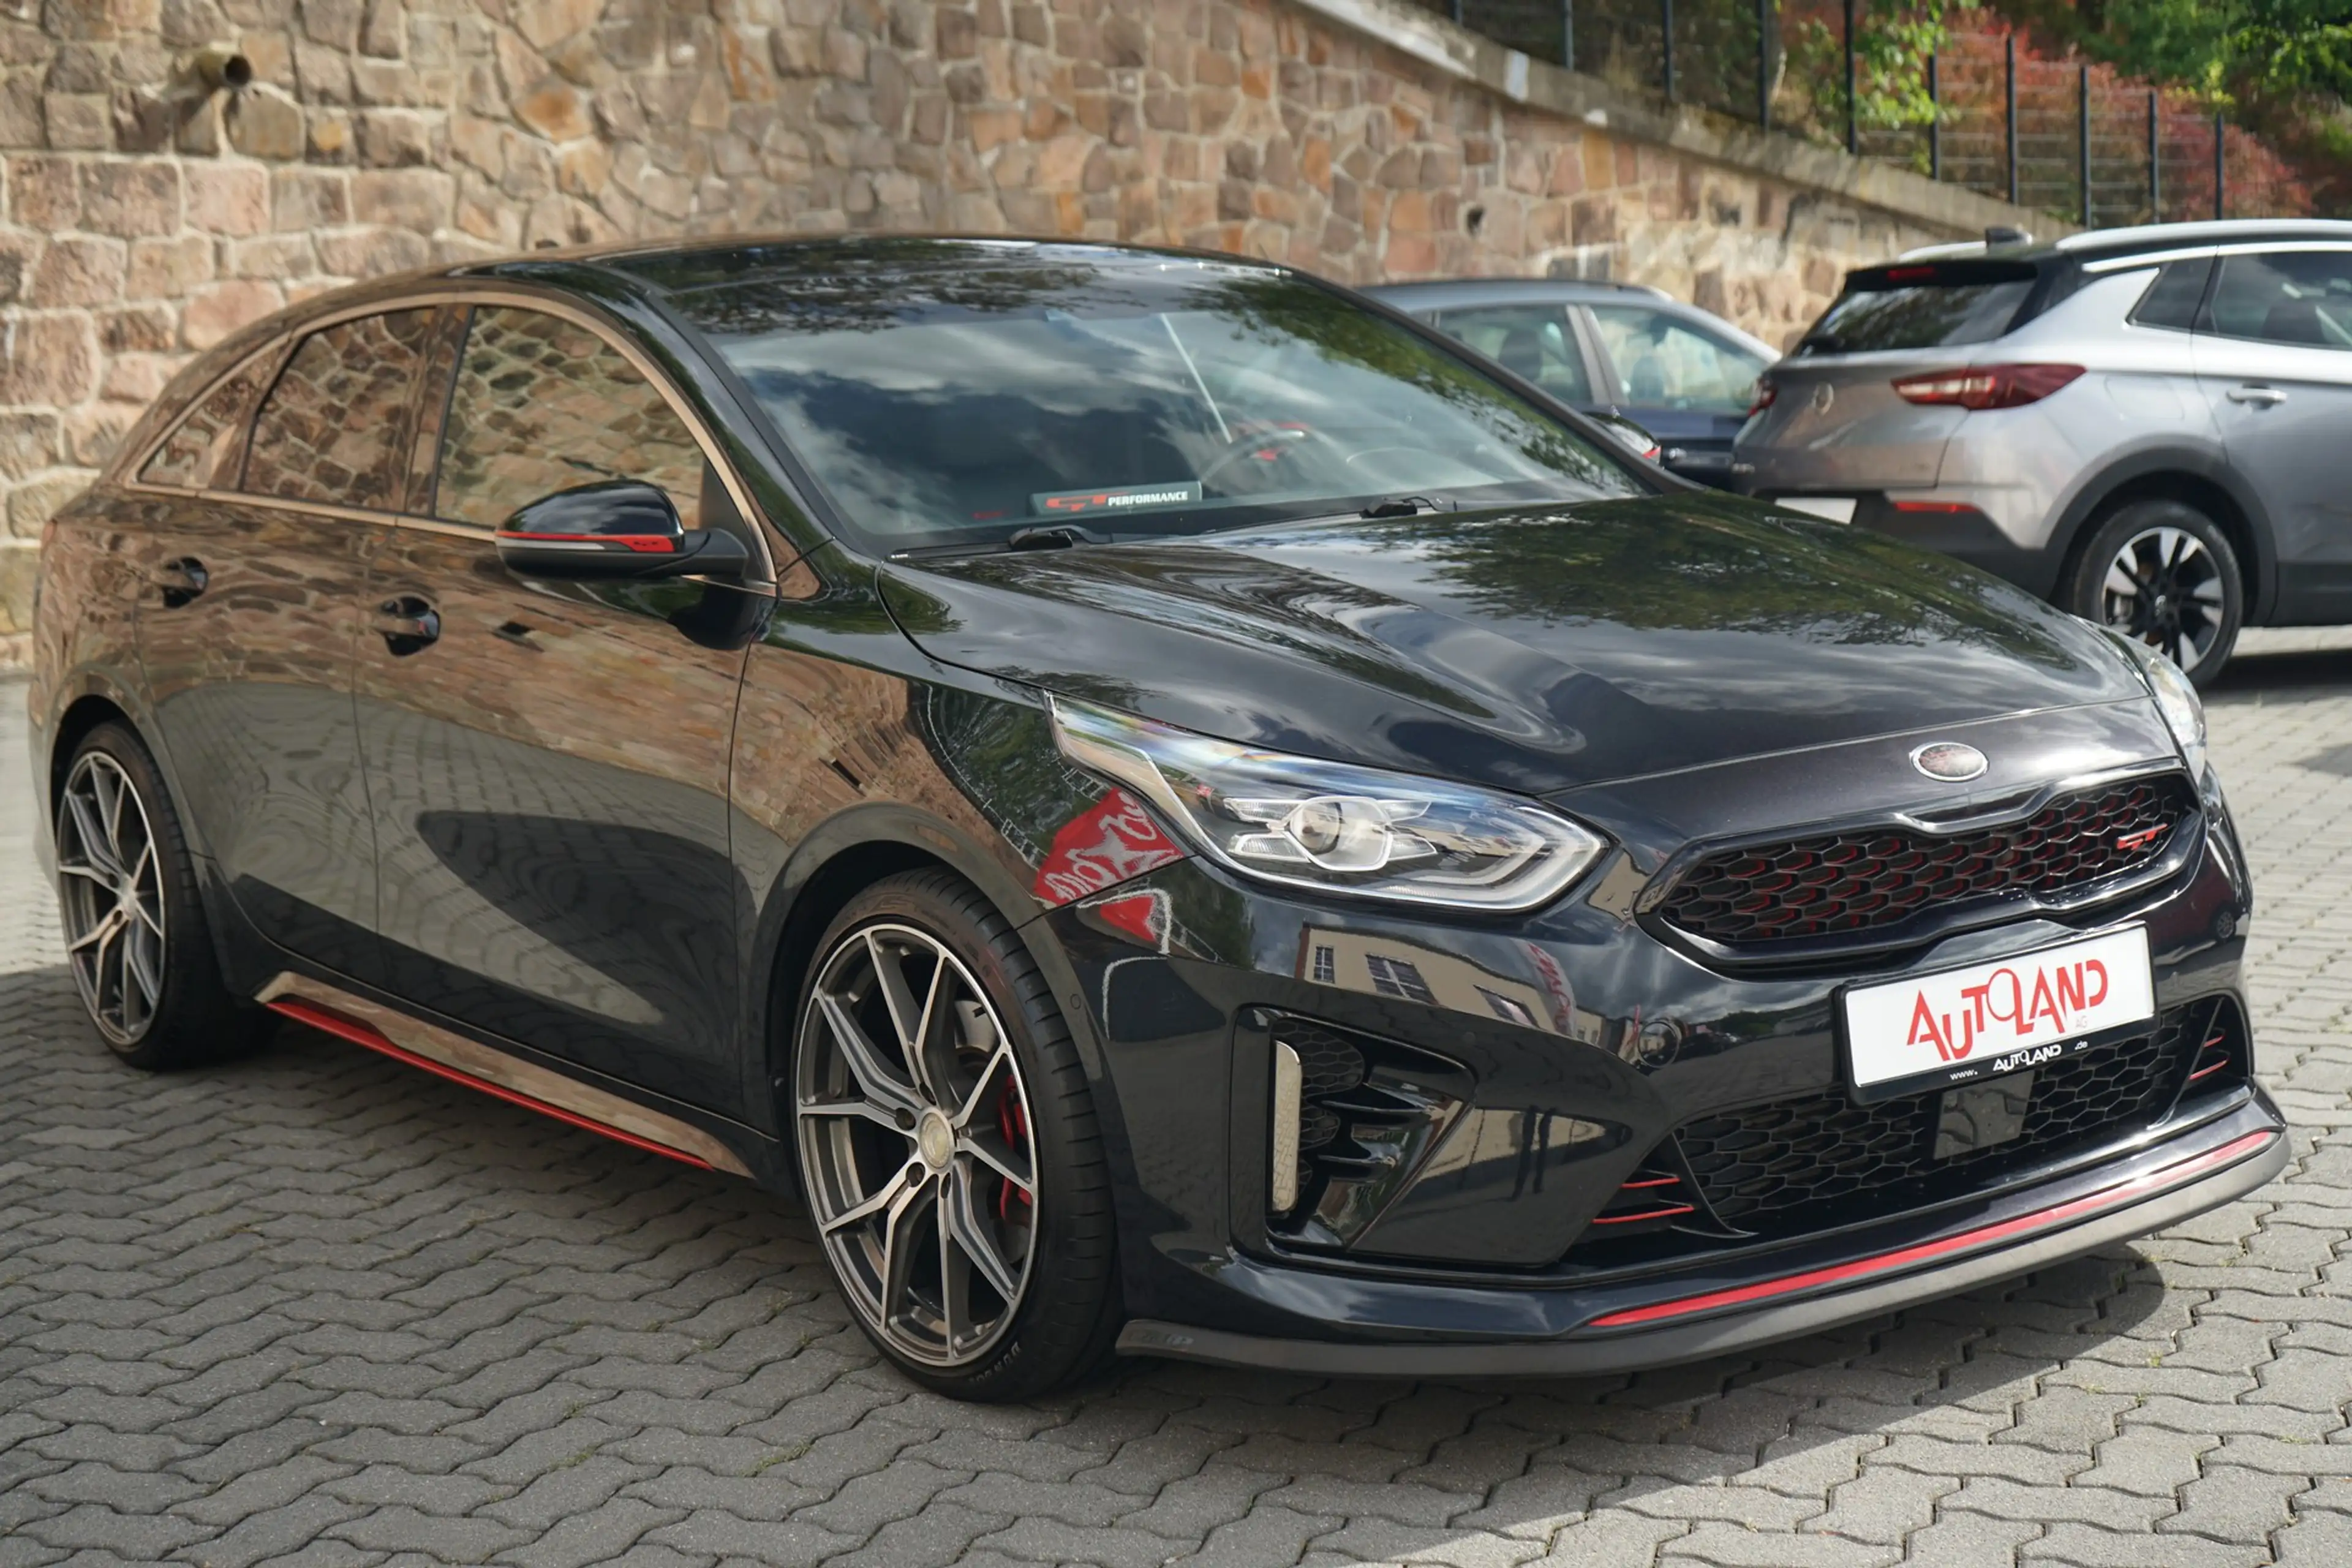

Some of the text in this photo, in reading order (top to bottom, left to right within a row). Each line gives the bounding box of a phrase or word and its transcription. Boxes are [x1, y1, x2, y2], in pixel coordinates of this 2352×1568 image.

[1108, 491, 1188, 507] PERFORMANCE
[1907, 959, 2108, 1061] AUTOLAND
[1950, 1068, 1978, 1081] www.
[1992, 1044, 2062, 1072] AUTOLAND
